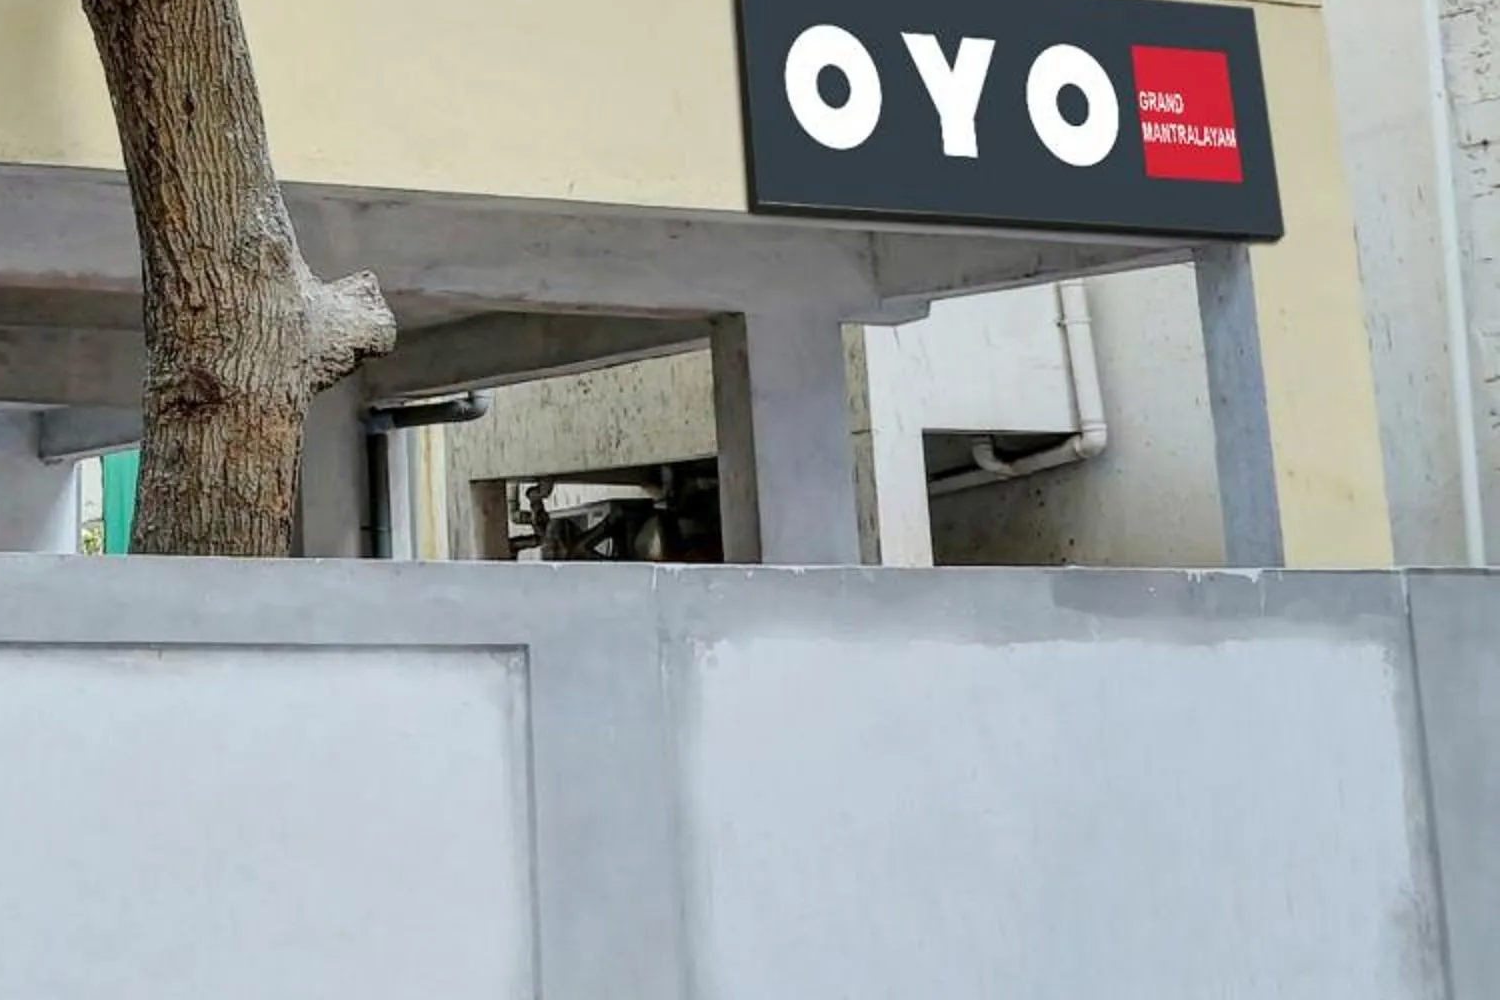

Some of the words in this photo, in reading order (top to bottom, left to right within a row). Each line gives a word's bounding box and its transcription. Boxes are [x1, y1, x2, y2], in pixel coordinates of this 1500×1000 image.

[785, 25, 1118, 166] OYO
[1139, 91, 1184, 115] GRAND
[1142, 122, 1237, 148] MANTRALAYAM
